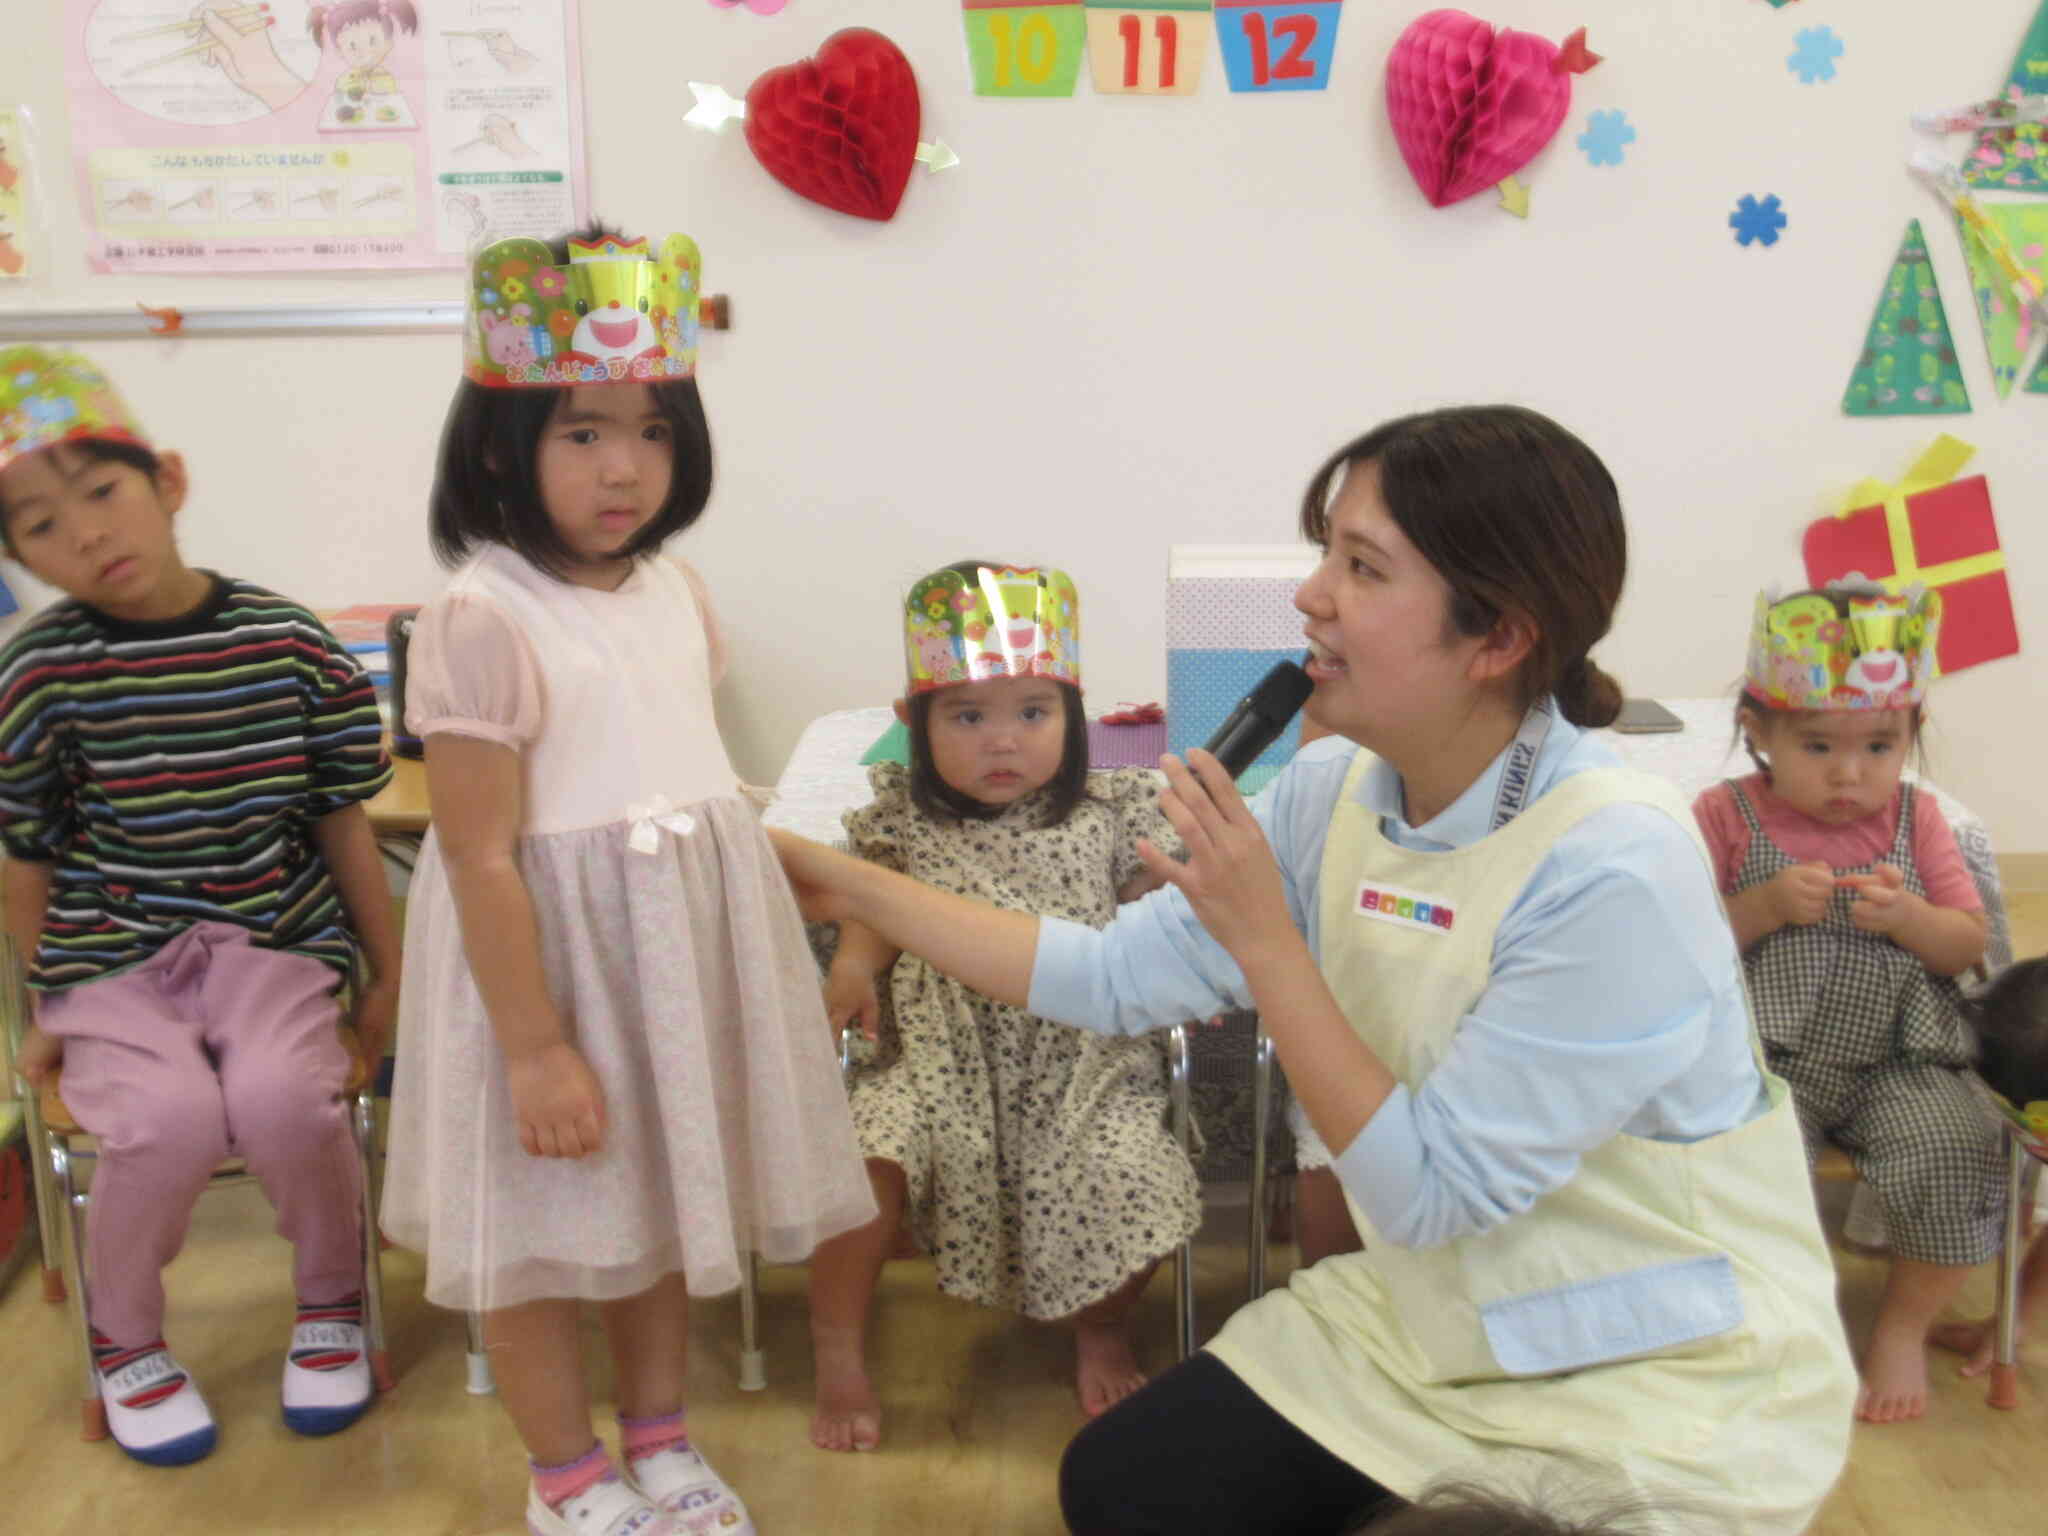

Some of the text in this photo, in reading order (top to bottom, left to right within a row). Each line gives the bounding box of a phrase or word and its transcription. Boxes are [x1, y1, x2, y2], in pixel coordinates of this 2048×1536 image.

[988, 13, 1057, 87] 10
[1119, 14, 1178, 88] 11
[1241, 12, 1318, 87] 12
